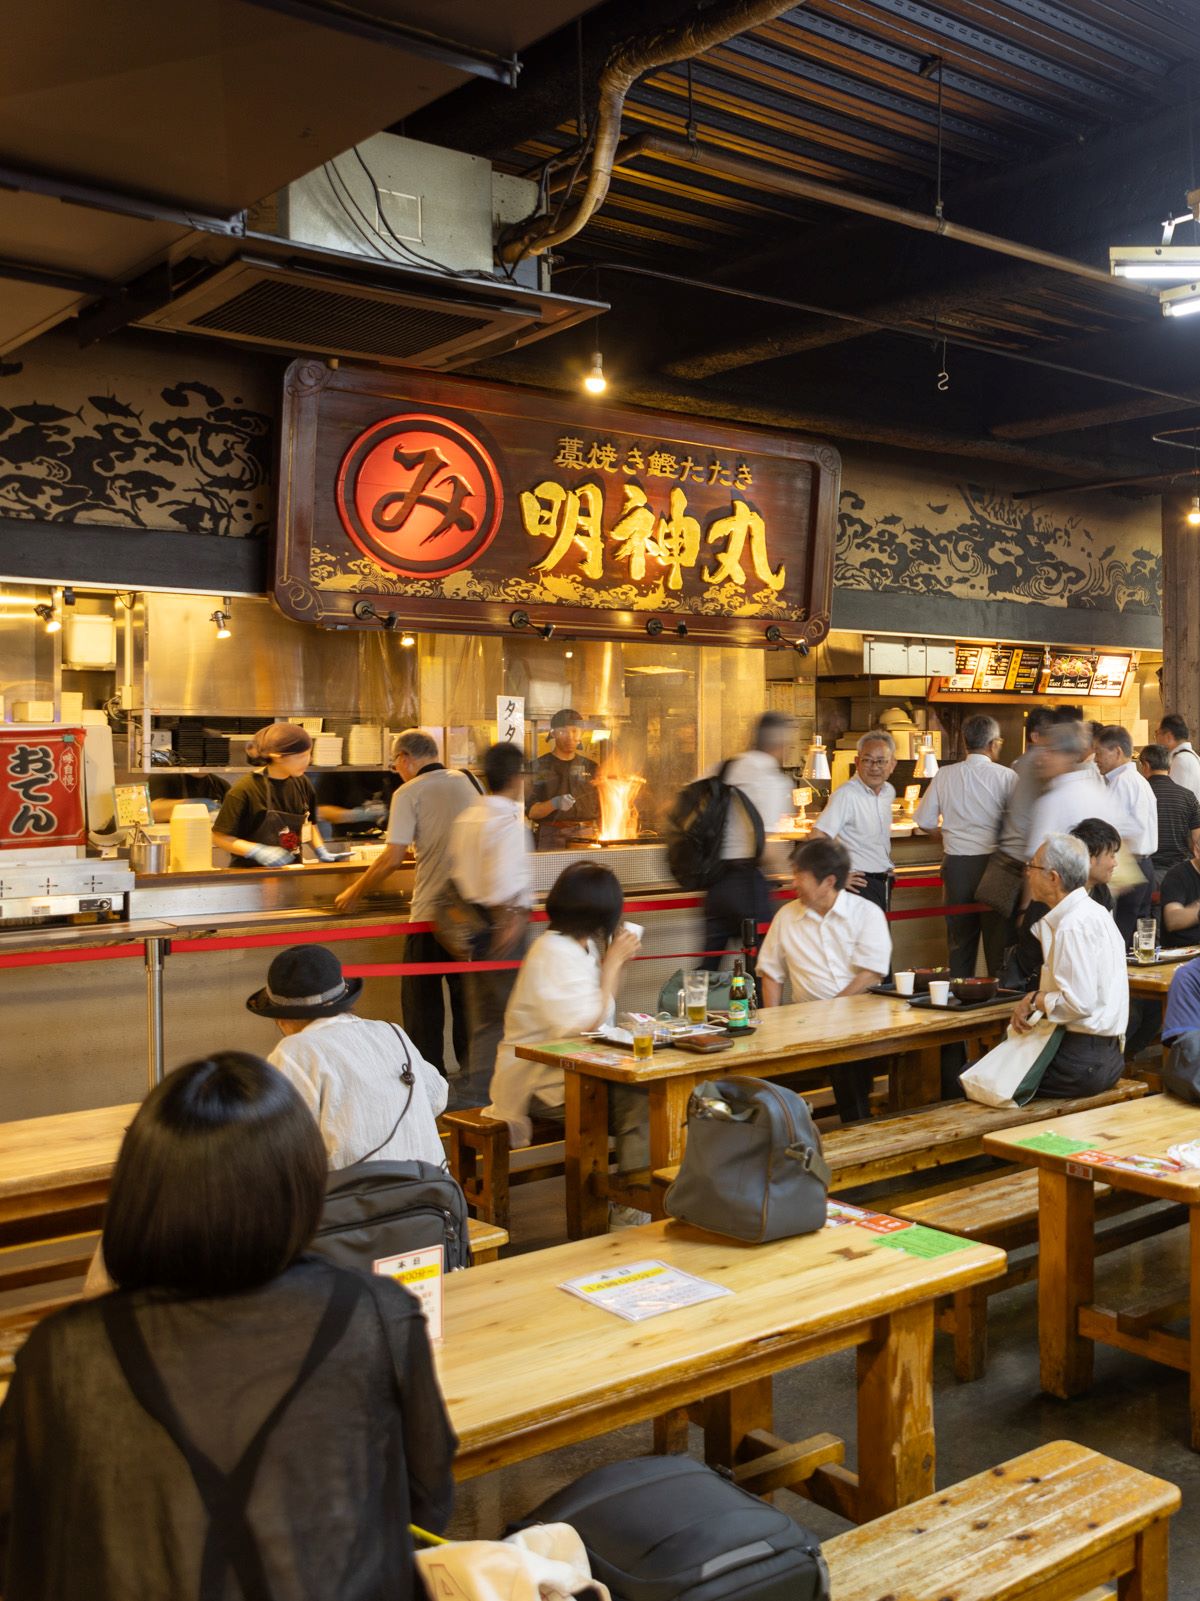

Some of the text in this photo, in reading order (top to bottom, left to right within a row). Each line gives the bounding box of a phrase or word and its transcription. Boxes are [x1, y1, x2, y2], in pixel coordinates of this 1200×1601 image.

[371, 444, 478, 547] み
[555, 436, 754, 490] 藁焼き鰹たたき
[519, 481, 785, 591] 明神丸
[8, 744, 58, 835] おでん
[62, 753, 75, 787] 味自慢
